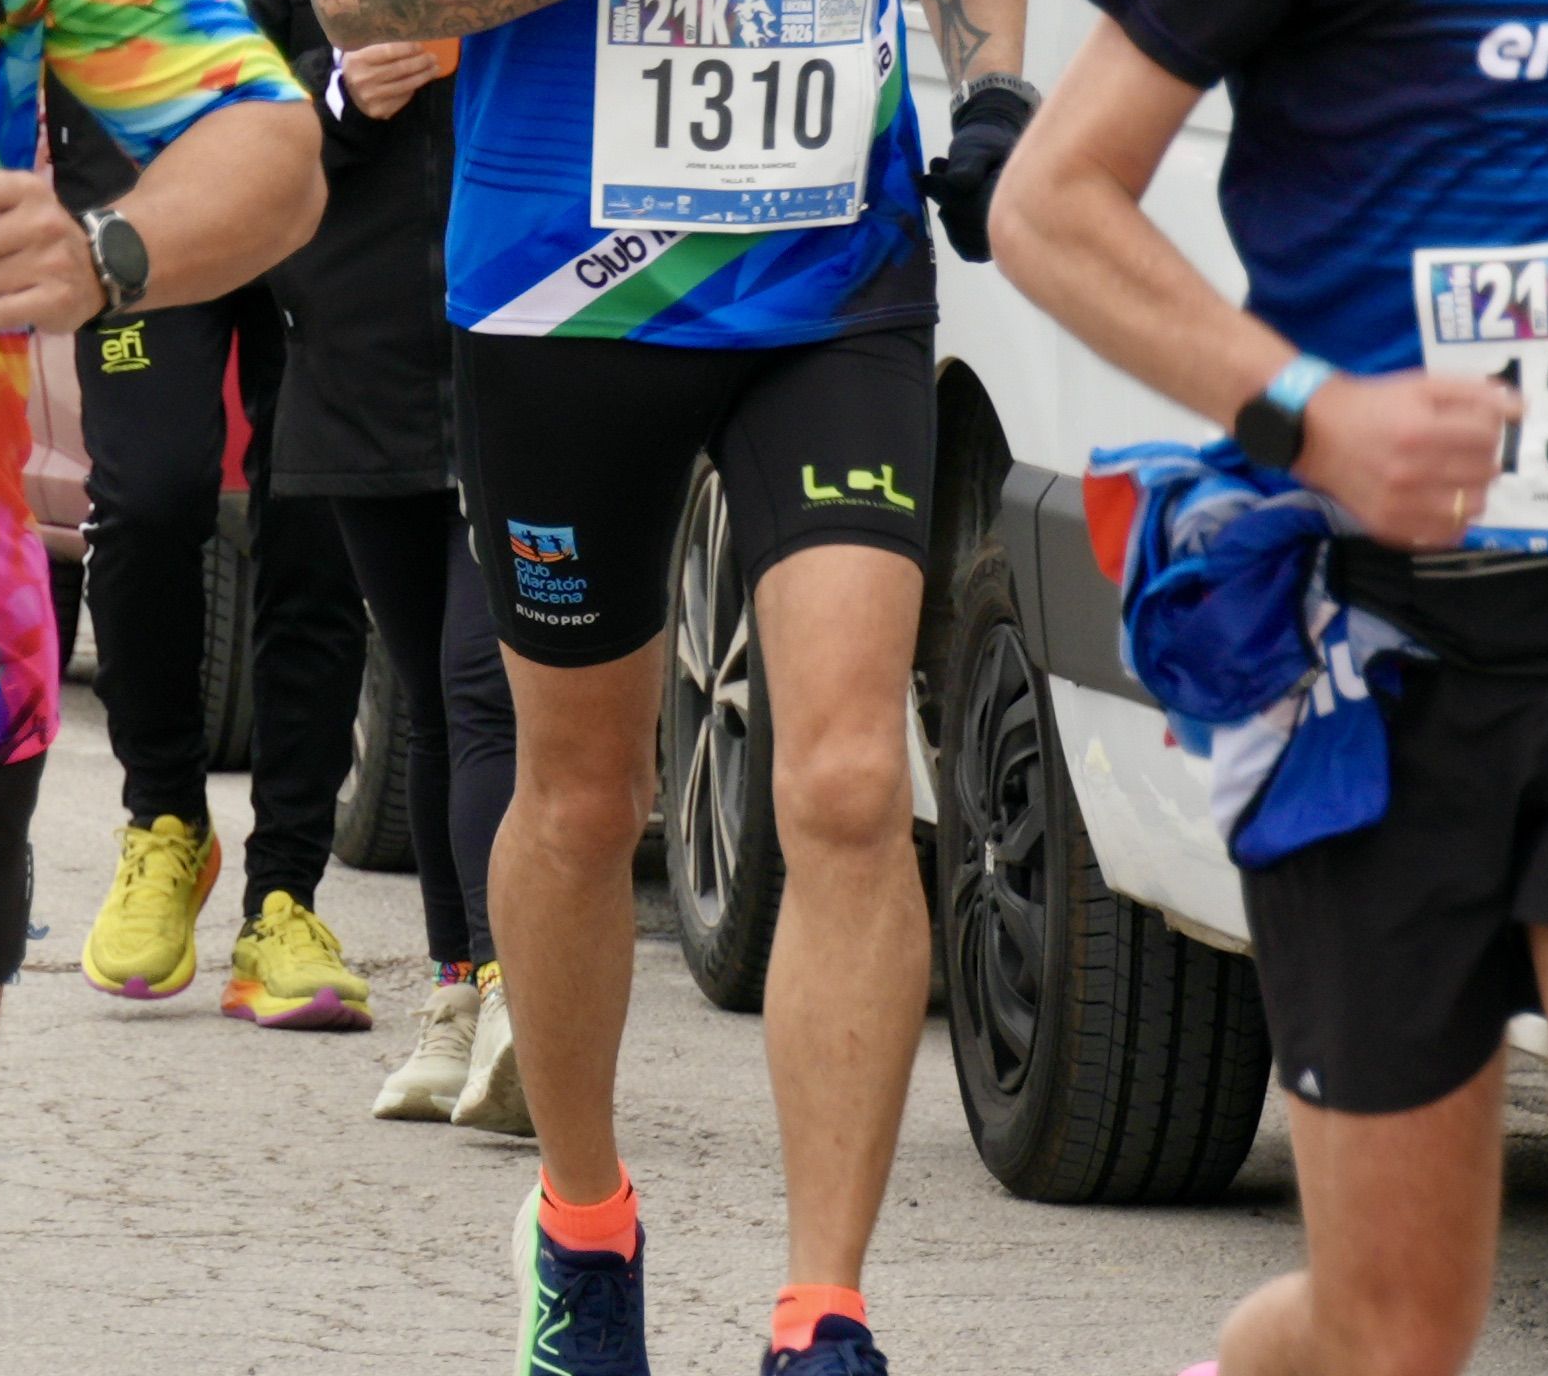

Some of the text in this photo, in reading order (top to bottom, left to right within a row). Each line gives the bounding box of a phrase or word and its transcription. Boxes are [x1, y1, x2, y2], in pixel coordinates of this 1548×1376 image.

[641, 56, 836, 153] 1310
[575, 235, 647, 289] Club
[101, 330, 144, 362] efi
[513, 557, 551, 577] Club
[517, 571, 588, 591] Maratón
[519, 584, 584, 604] Lucena
[515, 603, 546, 623] RUN
